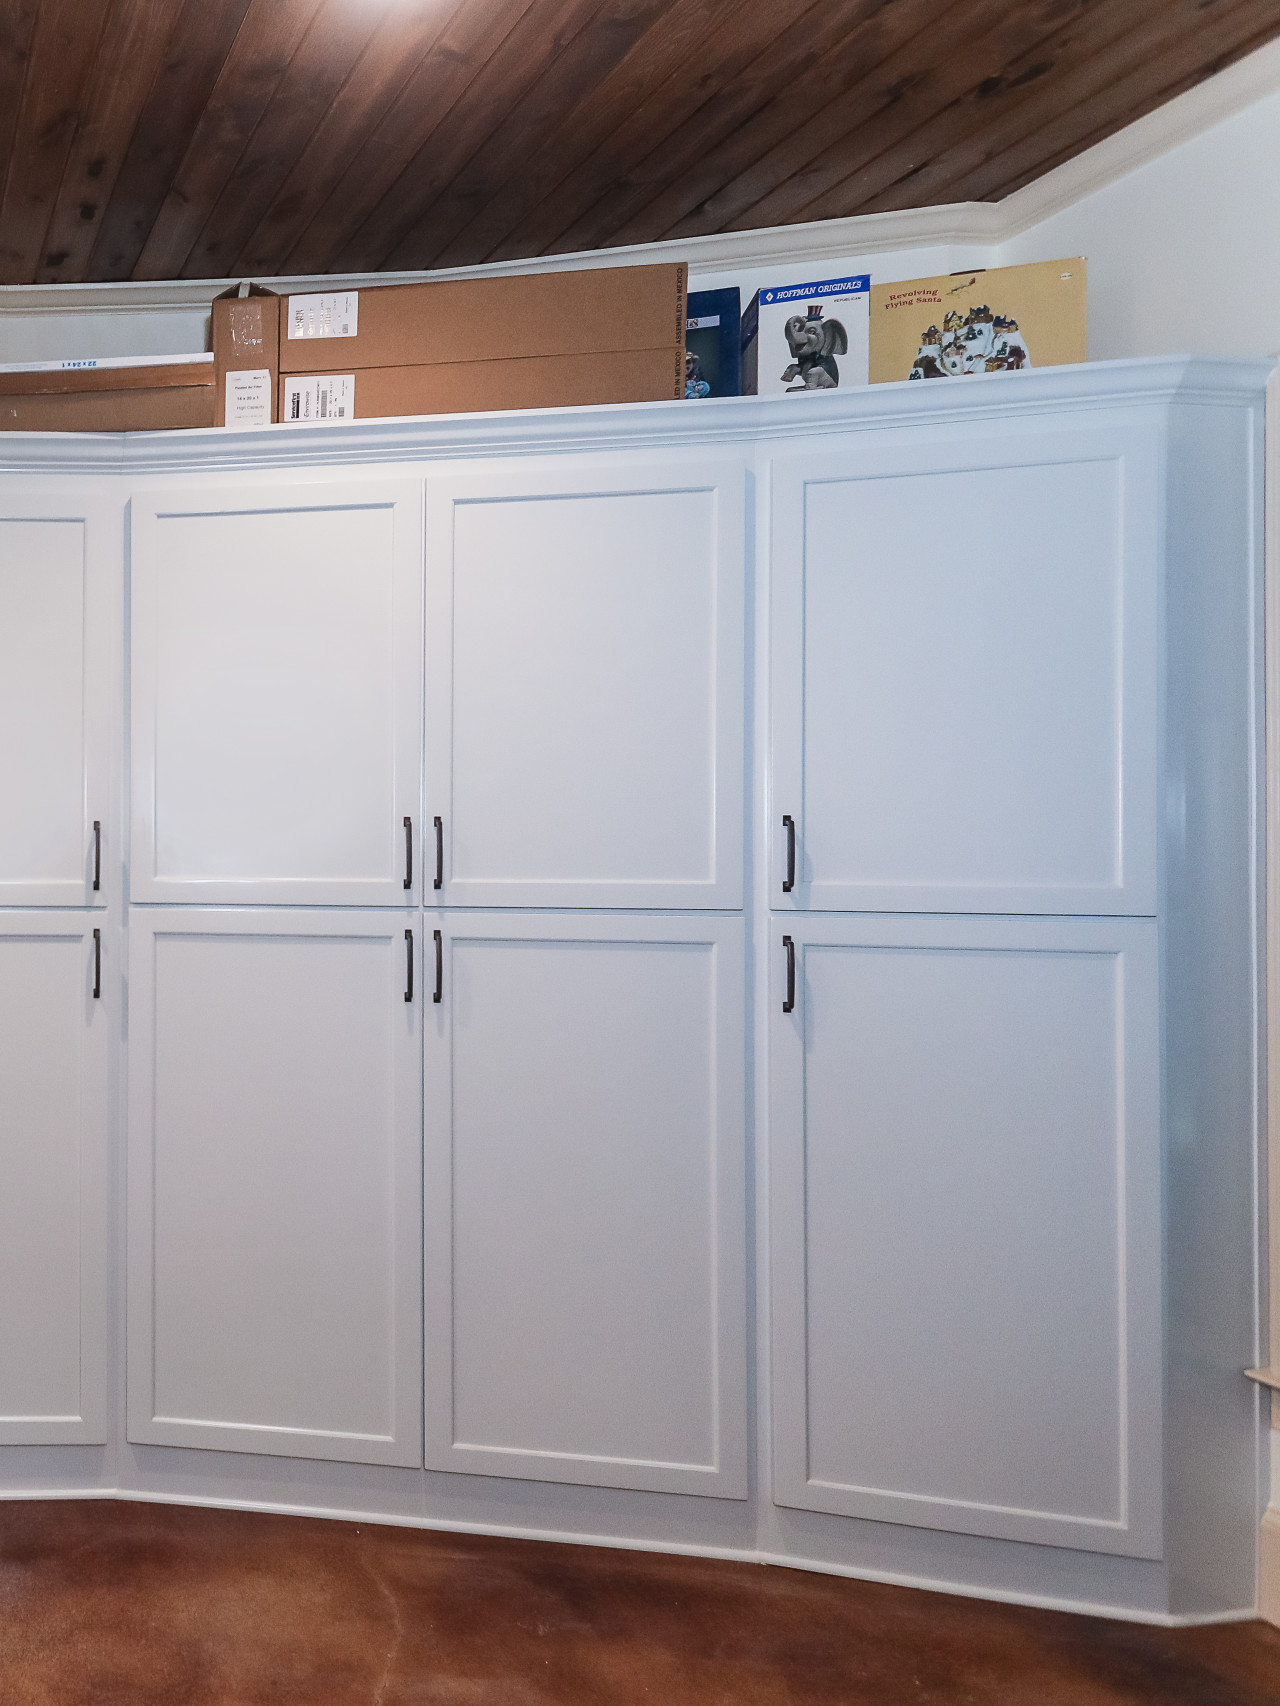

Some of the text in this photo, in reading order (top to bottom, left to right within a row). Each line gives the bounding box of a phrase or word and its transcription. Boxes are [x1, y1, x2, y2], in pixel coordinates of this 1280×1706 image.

[776, 280, 862, 300] HOFFMAN ORIGINALS
[889, 288, 939, 301] Revolving
[885, 298, 914, 310] Flying
[674, 378, 681, 386] IN
